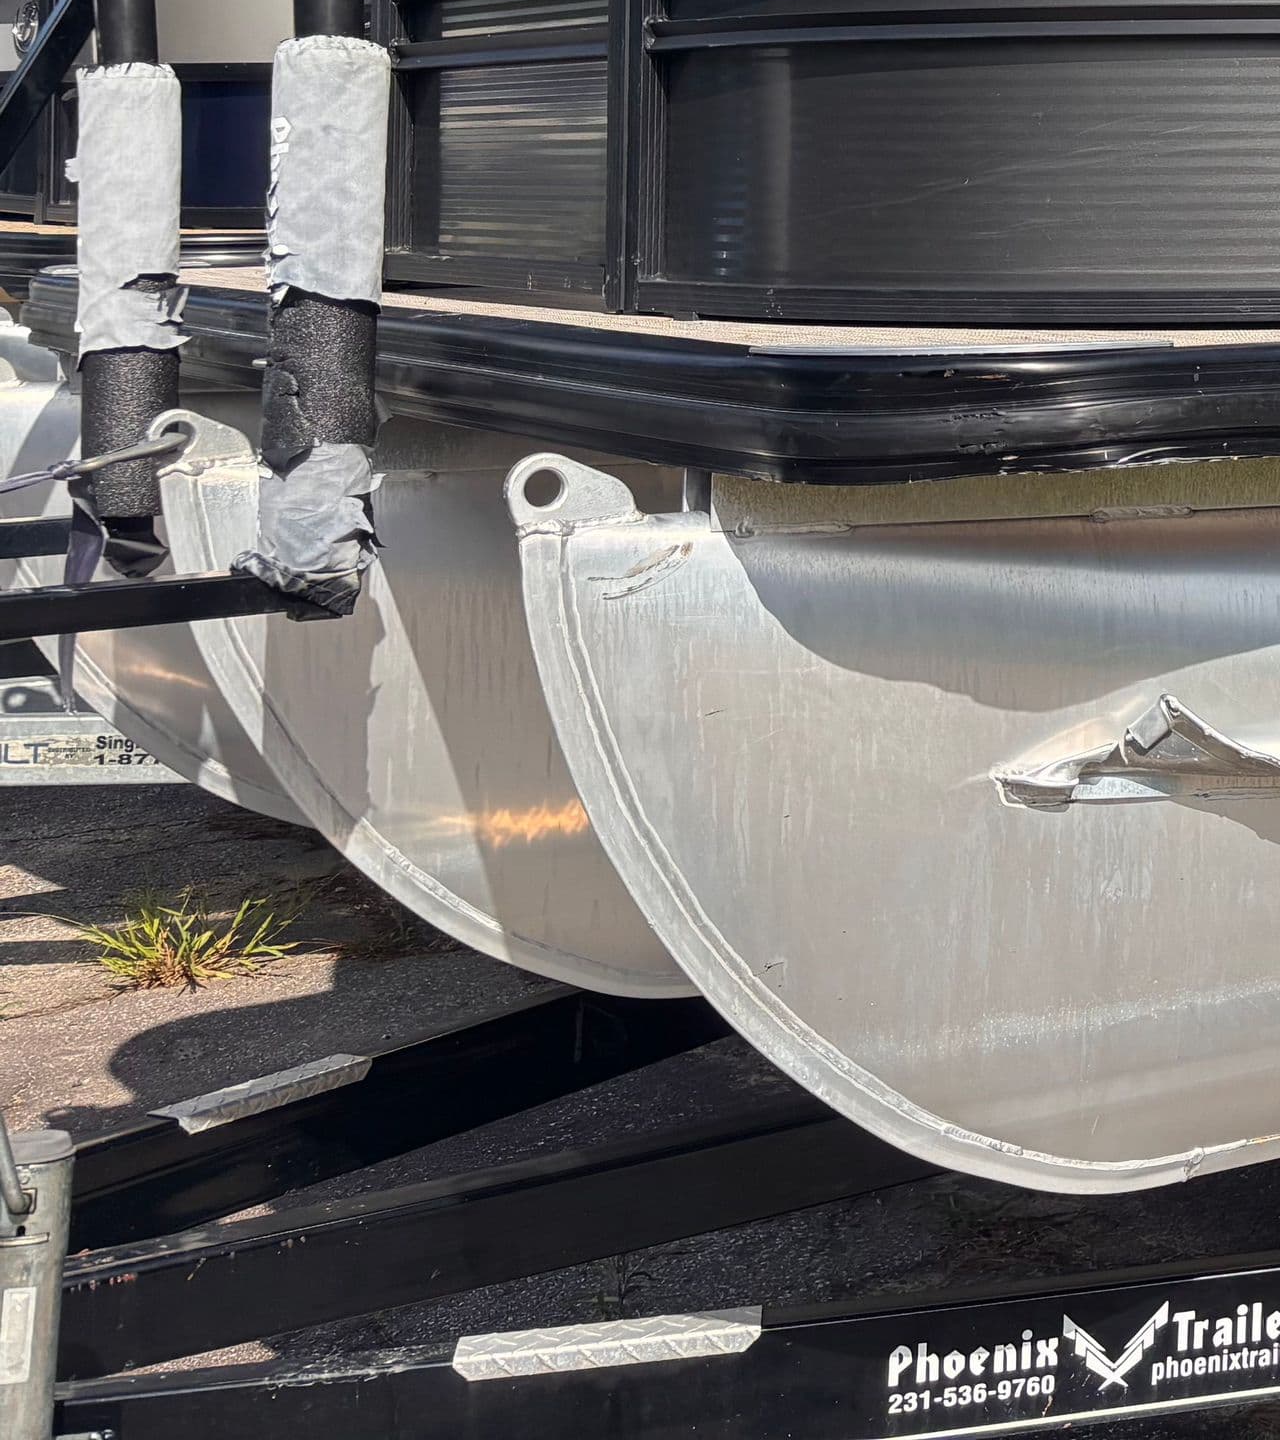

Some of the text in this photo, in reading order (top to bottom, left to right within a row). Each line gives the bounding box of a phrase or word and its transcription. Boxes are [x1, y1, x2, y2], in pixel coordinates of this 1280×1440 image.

[0, 743, 49, 764] LT
[96, 735, 143, 753] Sing
[887, 1328, 1059, 1388] Phoenix
[887, 1374, 1056, 1414] 231-536-9760
